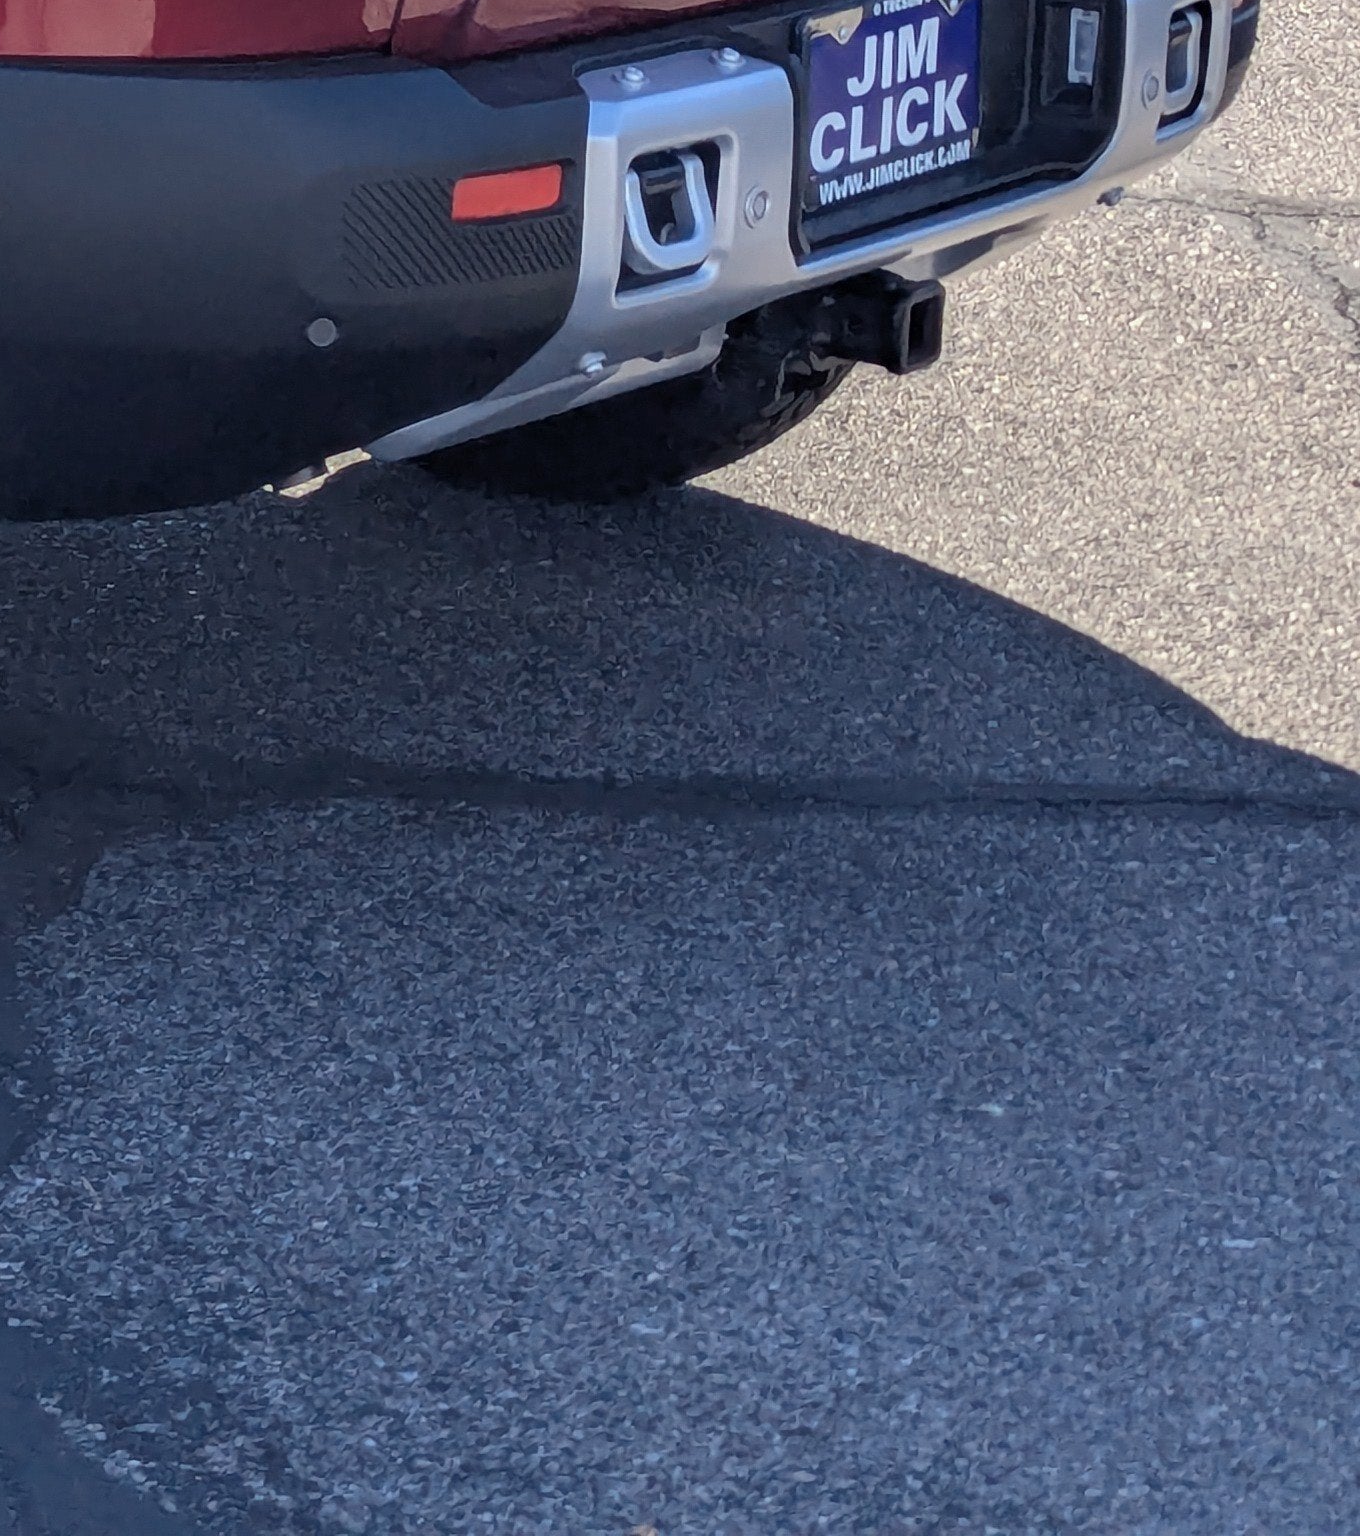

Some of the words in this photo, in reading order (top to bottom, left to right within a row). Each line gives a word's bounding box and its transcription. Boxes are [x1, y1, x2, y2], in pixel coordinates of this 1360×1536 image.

[846, 16, 941, 97] JIM
[809, 73, 969, 173] CLICK
[819, 139, 971, 206] WWW.JIMCLICK.COM
